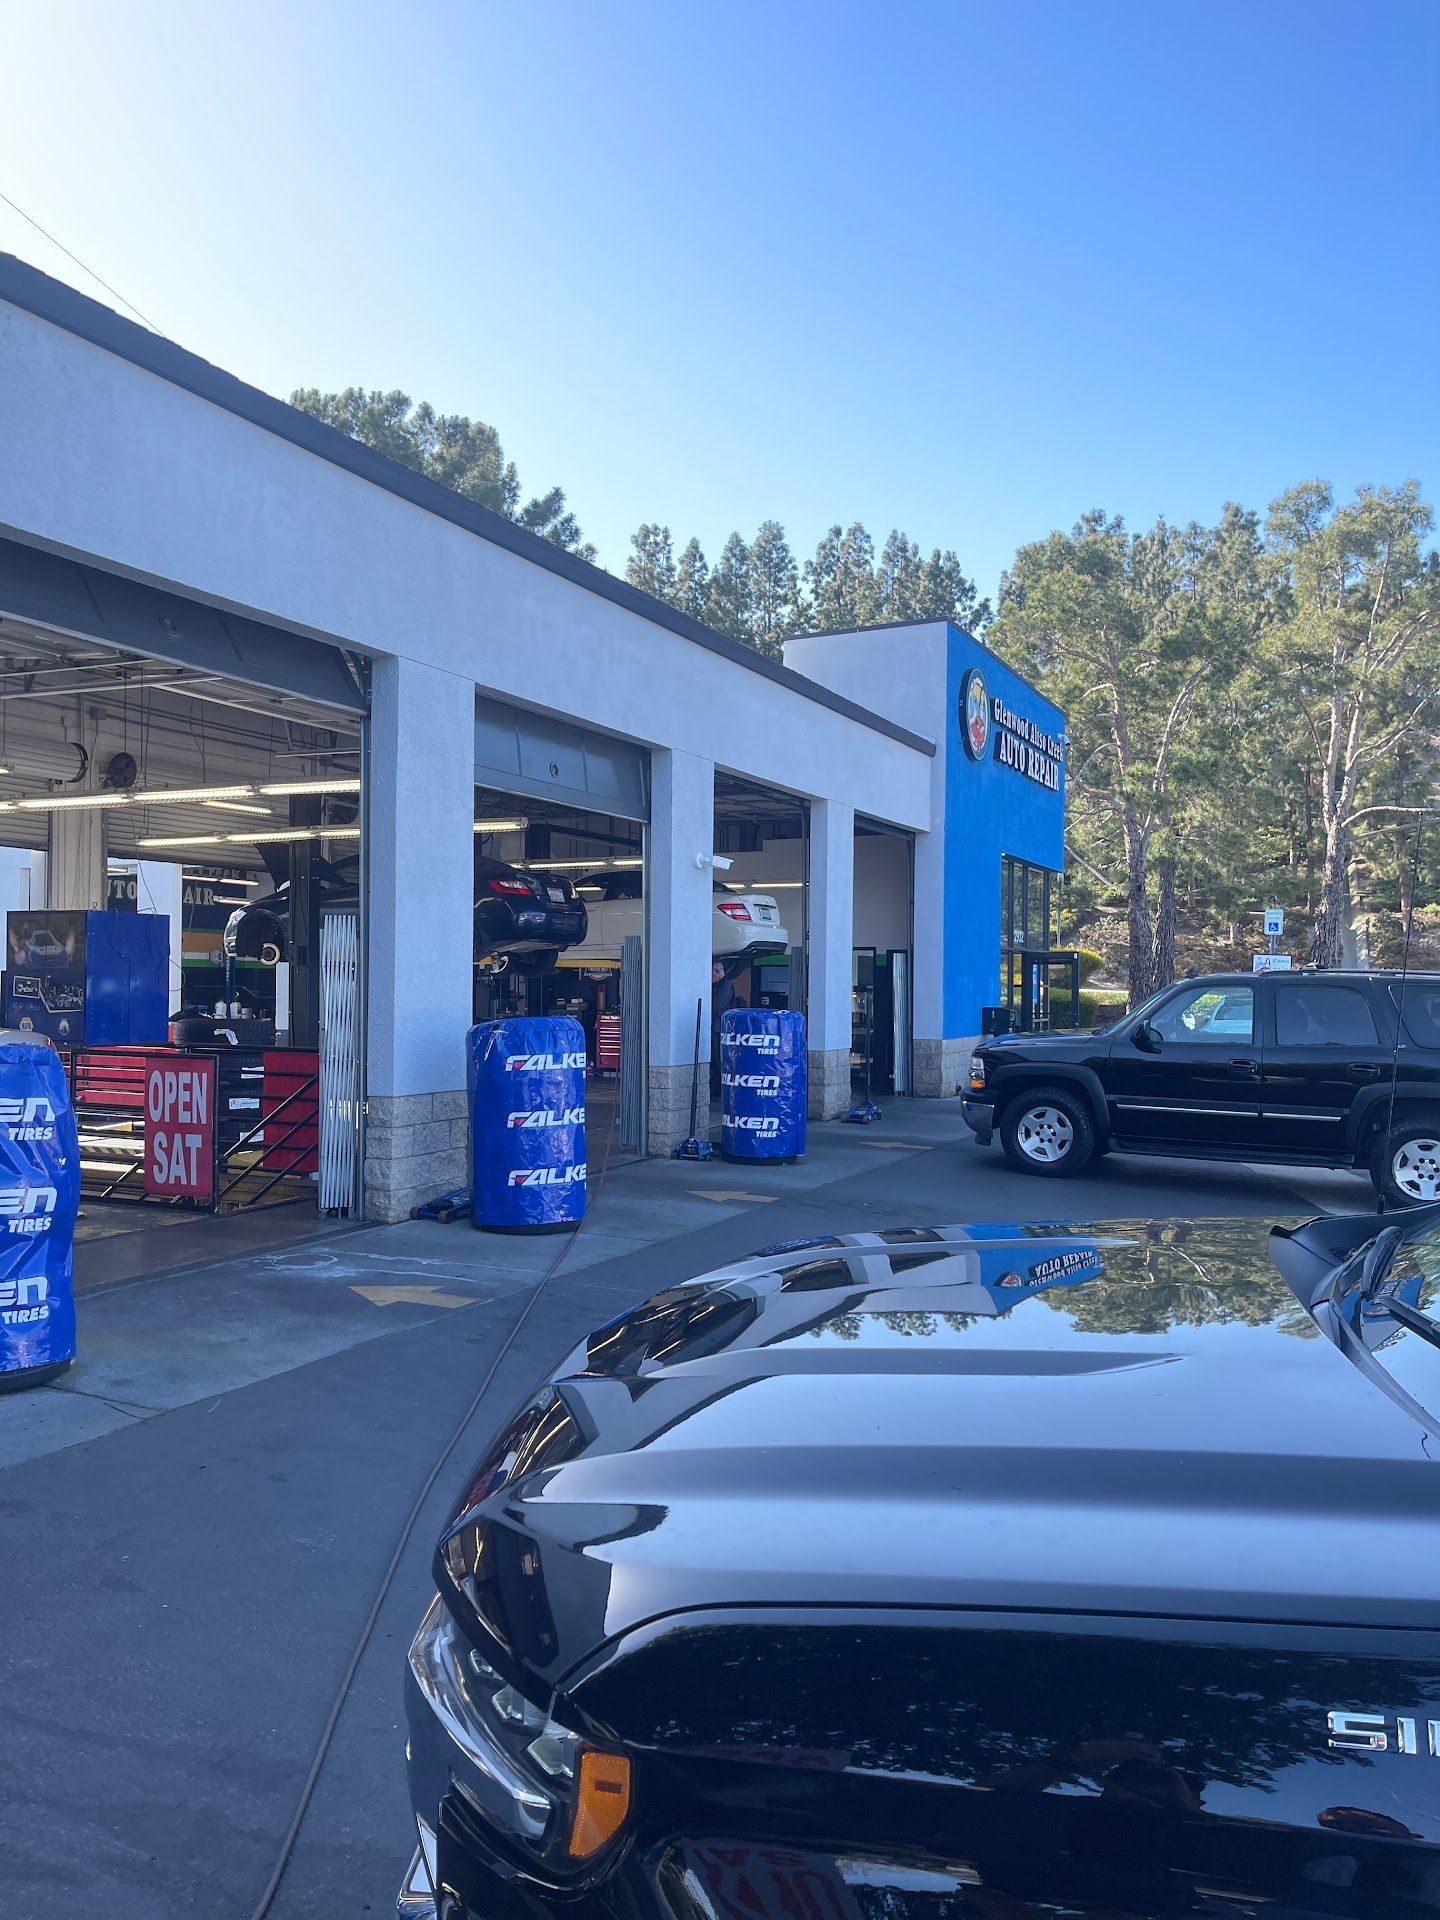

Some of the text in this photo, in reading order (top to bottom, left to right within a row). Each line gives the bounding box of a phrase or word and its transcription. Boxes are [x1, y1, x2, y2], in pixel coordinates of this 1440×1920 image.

[994, 698, 1029, 740] Glenwood
[1030, 723, 1046, 751] Aliso
[1000, 731, 1059, 791] AUTO REPAIR
[148, 1070, 208, 1125] OPEN
[8, 1127, 54, 1141] TIRES
[152, 1131, 203, 1186] SAT
[8, 1217, 52, 1234] TIRES
[2, 1305, 49, 1325] TIRES
